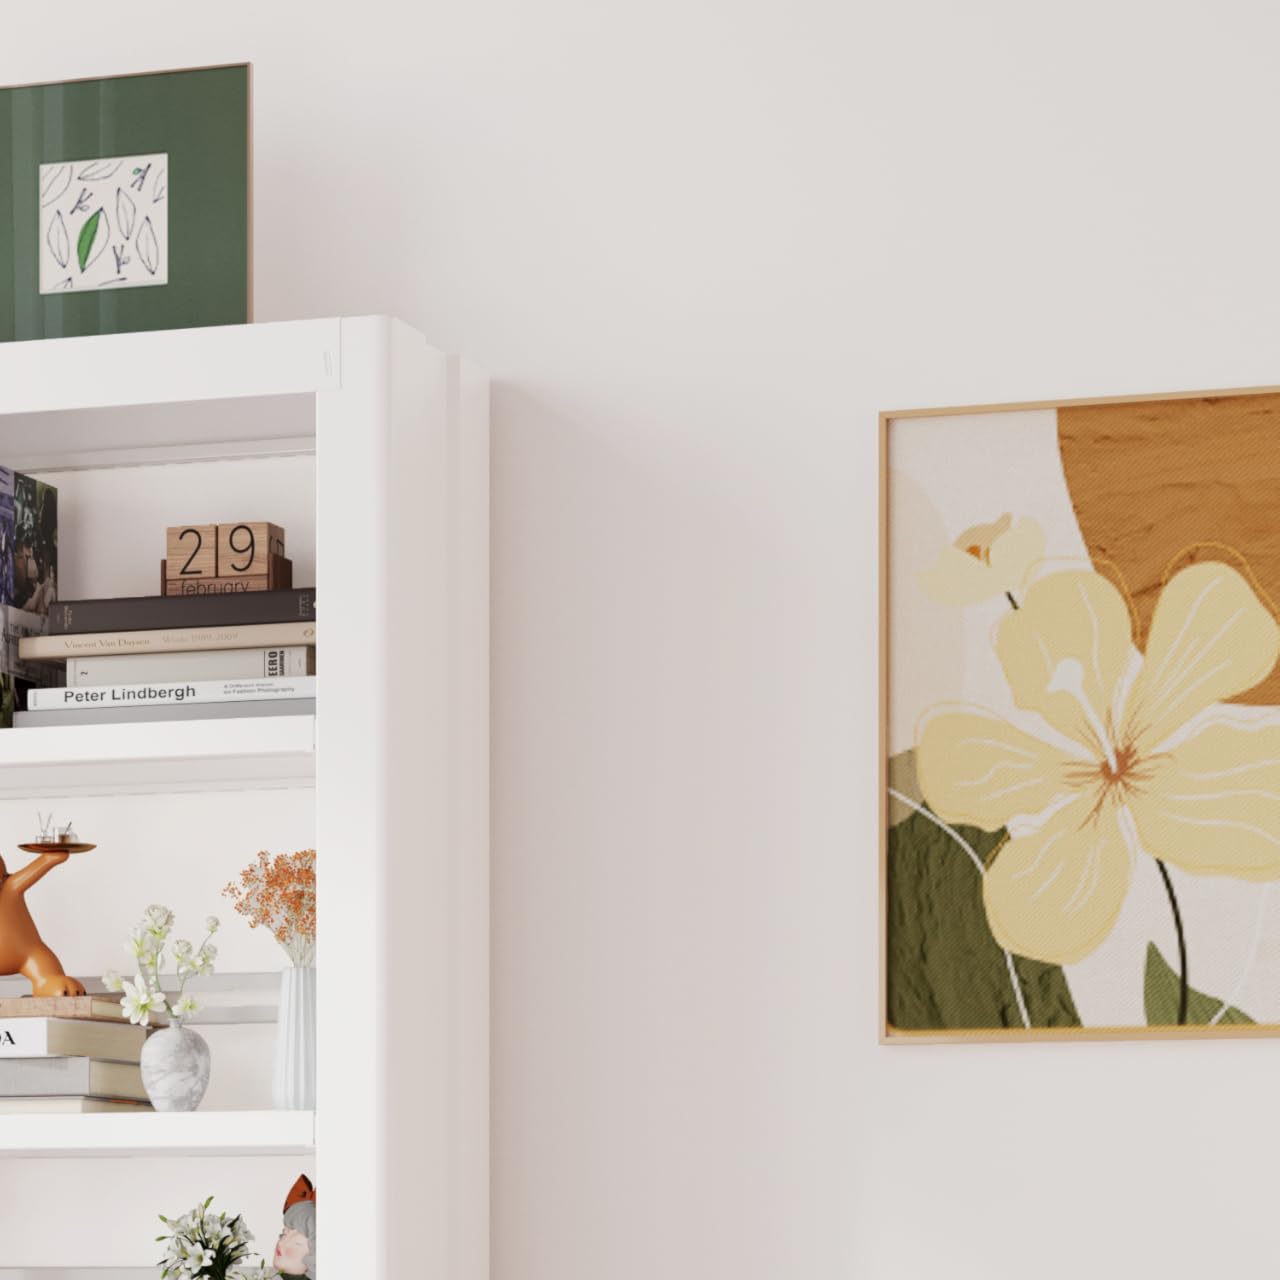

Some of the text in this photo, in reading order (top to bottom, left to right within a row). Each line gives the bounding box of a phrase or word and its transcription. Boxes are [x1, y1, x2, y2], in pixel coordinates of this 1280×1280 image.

[178, 524, 256, 575] 2 9
[181, 579, 250, 597] february
[64, 640, 97, 650] Vincent
[118, 638, 150, 649] Duysen
[268, 651, 278, 677] EERO
[63, 685, 197, 704] Peter Lindbergh
